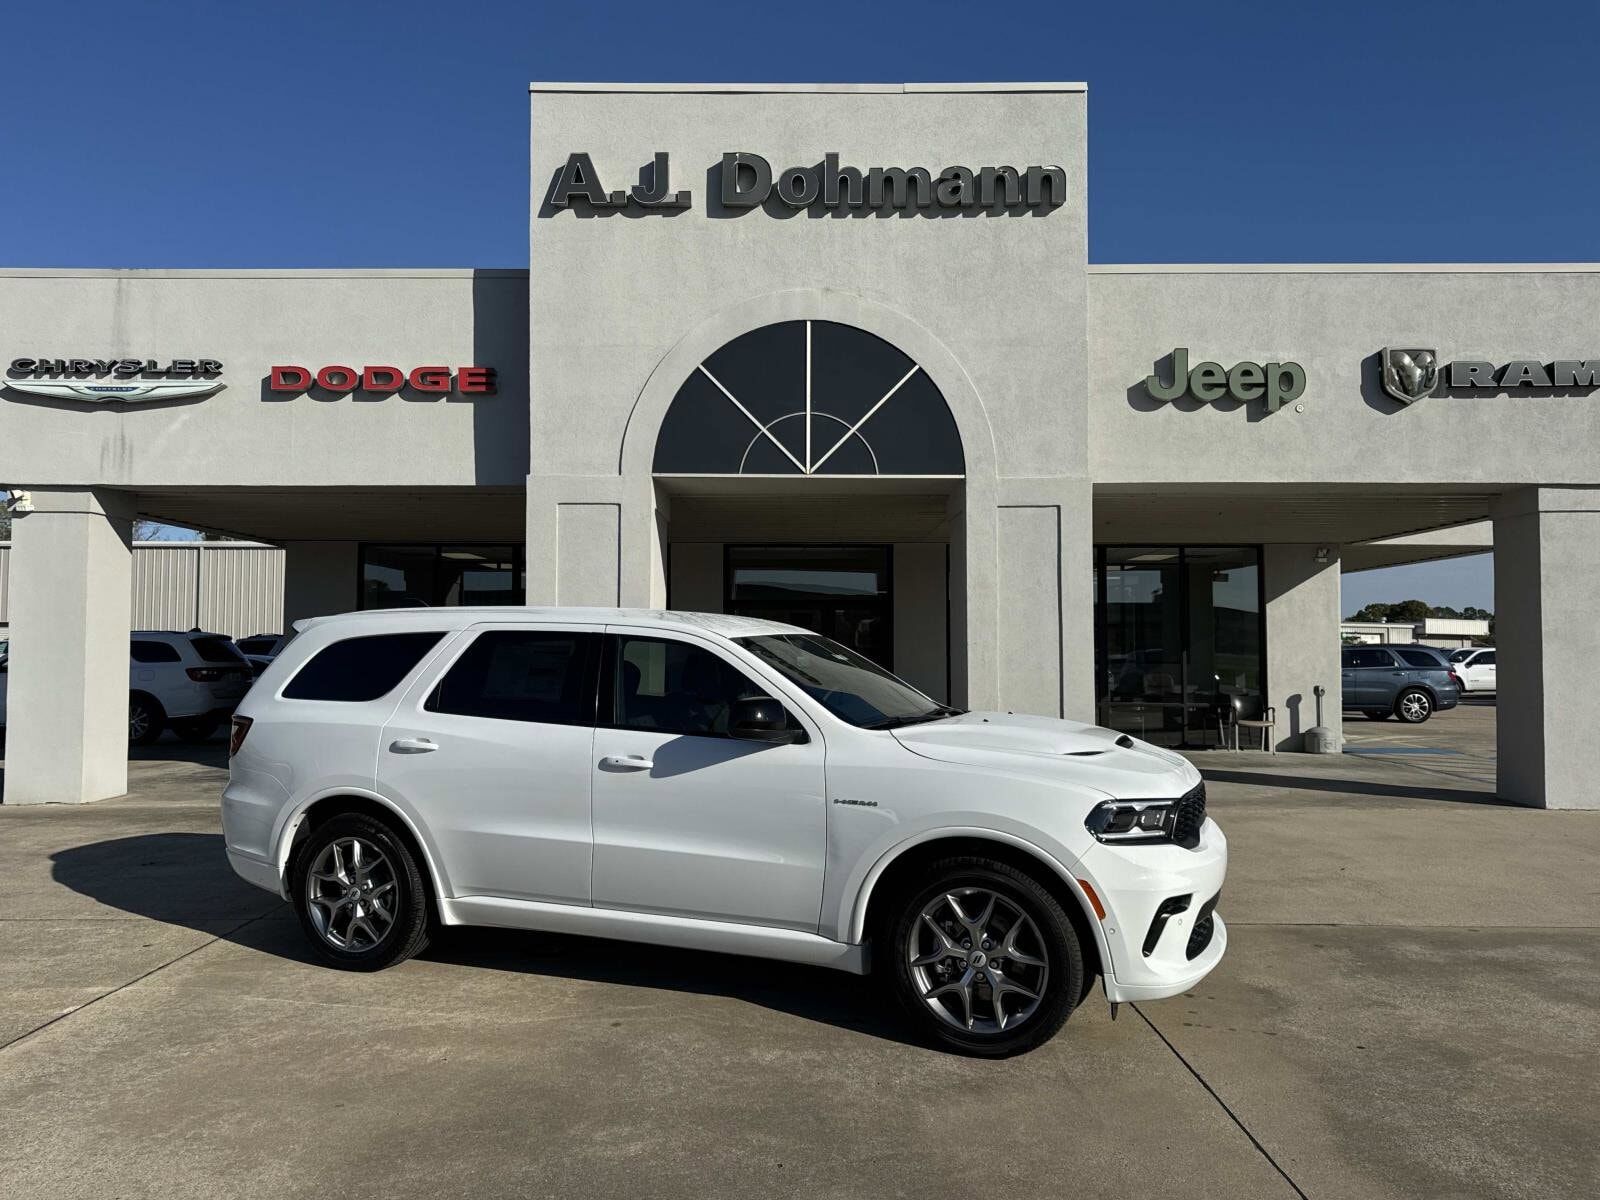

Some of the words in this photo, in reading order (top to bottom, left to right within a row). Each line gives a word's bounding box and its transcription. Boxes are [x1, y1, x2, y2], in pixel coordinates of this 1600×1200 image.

[549, 151, 692, 208] A.J.
[720, 151, 1068, 208] Dohmann
[9, 357, 224, 375] CHRYSLER
[269, 365, 494, 394] DODGE
[1146, 347, 1307, 413] Jeep
[1450, 359, 1600, 388] RAM
